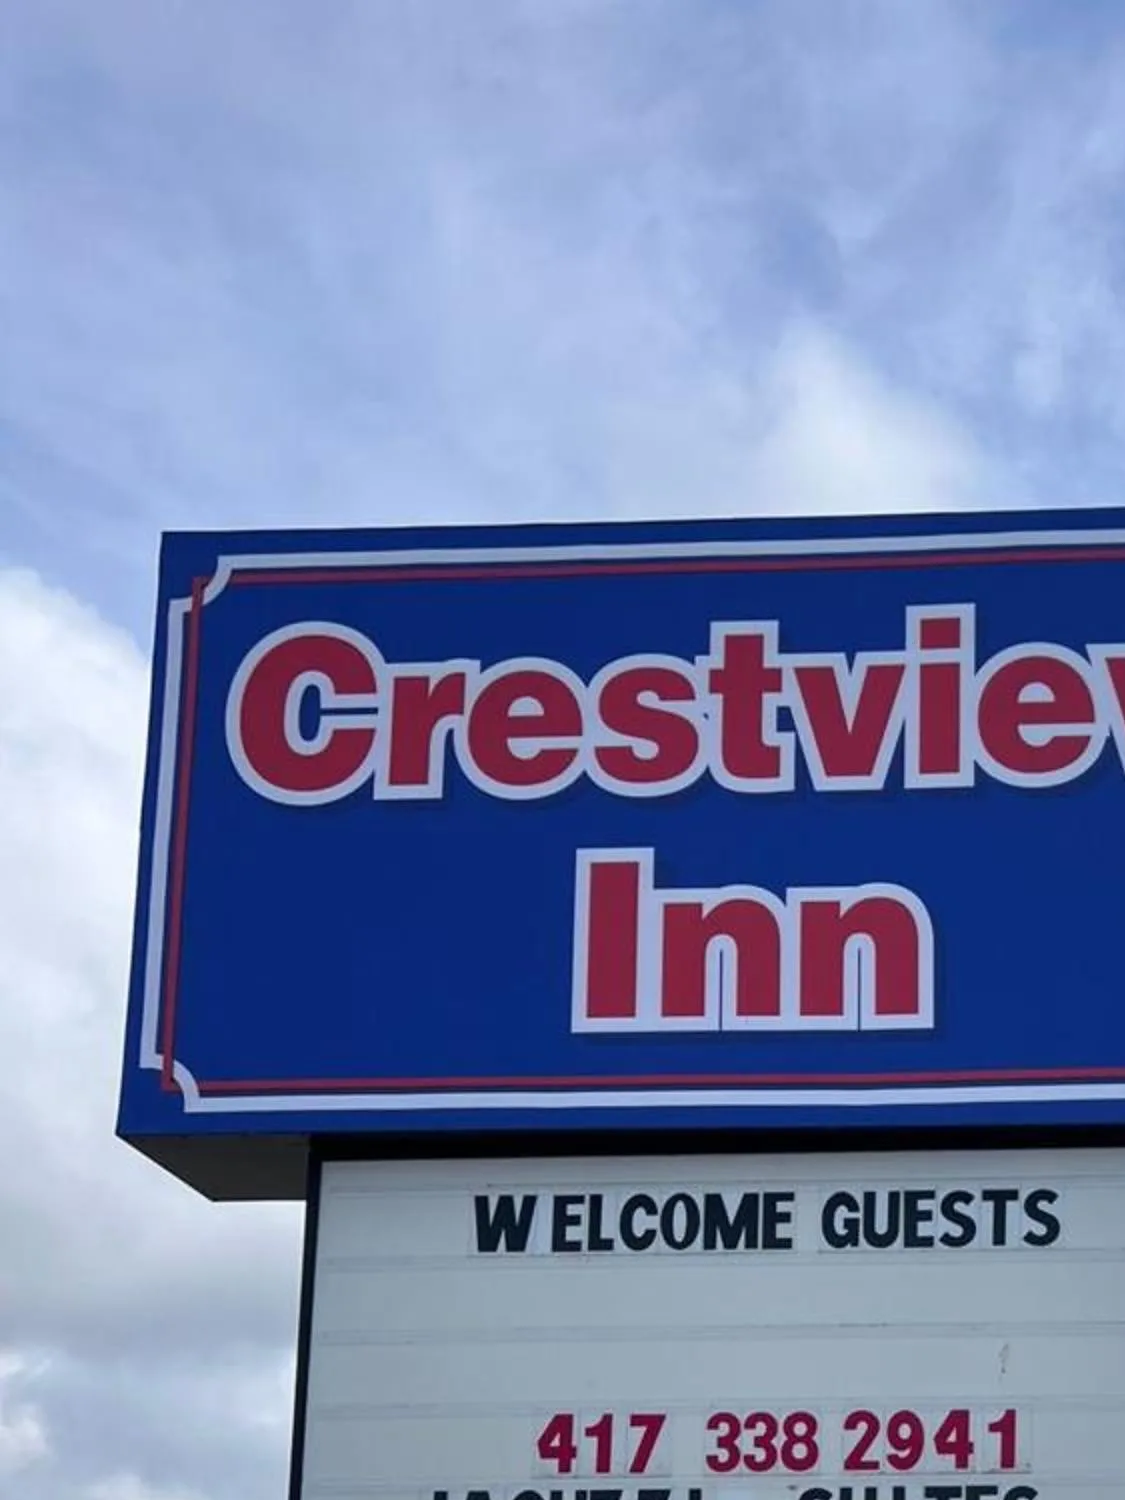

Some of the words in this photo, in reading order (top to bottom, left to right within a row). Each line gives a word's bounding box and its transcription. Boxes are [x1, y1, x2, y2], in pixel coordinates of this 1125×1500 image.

[572, 848, 933, 1032] Inn
[475, 1192, 794, 1252] WELCOME
[822, 1190, 1060, 1248] GUESTS
[538, 1413, 667, 1474] 417
[706, 1412, 819, 1472] 338
[843, 1409, 1019, 1471] 2941
